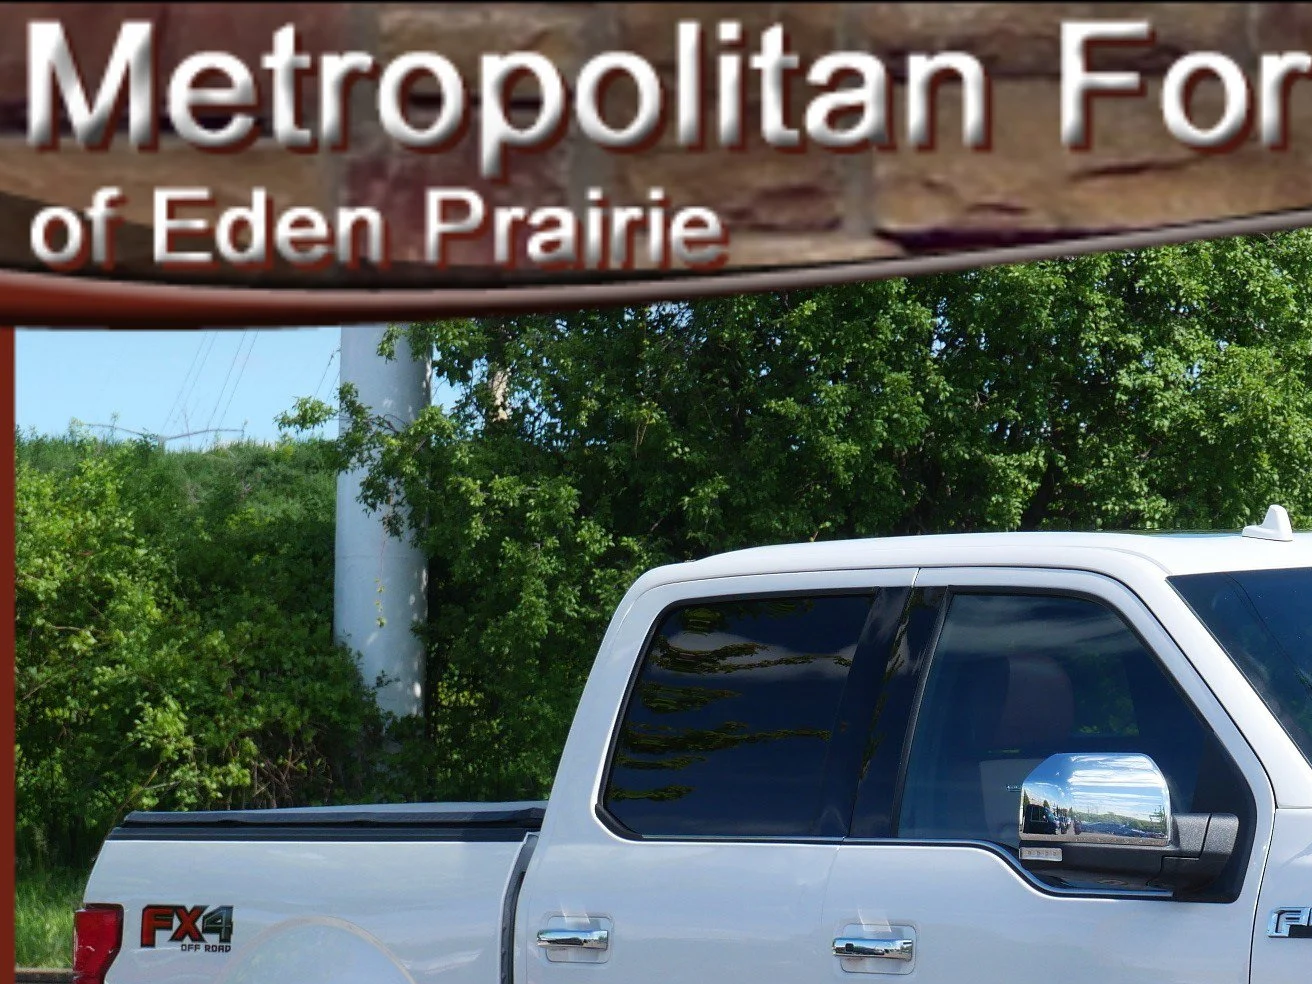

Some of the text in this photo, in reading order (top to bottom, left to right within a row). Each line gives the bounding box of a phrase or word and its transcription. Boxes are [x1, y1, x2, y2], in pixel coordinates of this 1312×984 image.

[140, 905, 234, 948] FX4
[180, 944, 232, 953] OFF ROAD
